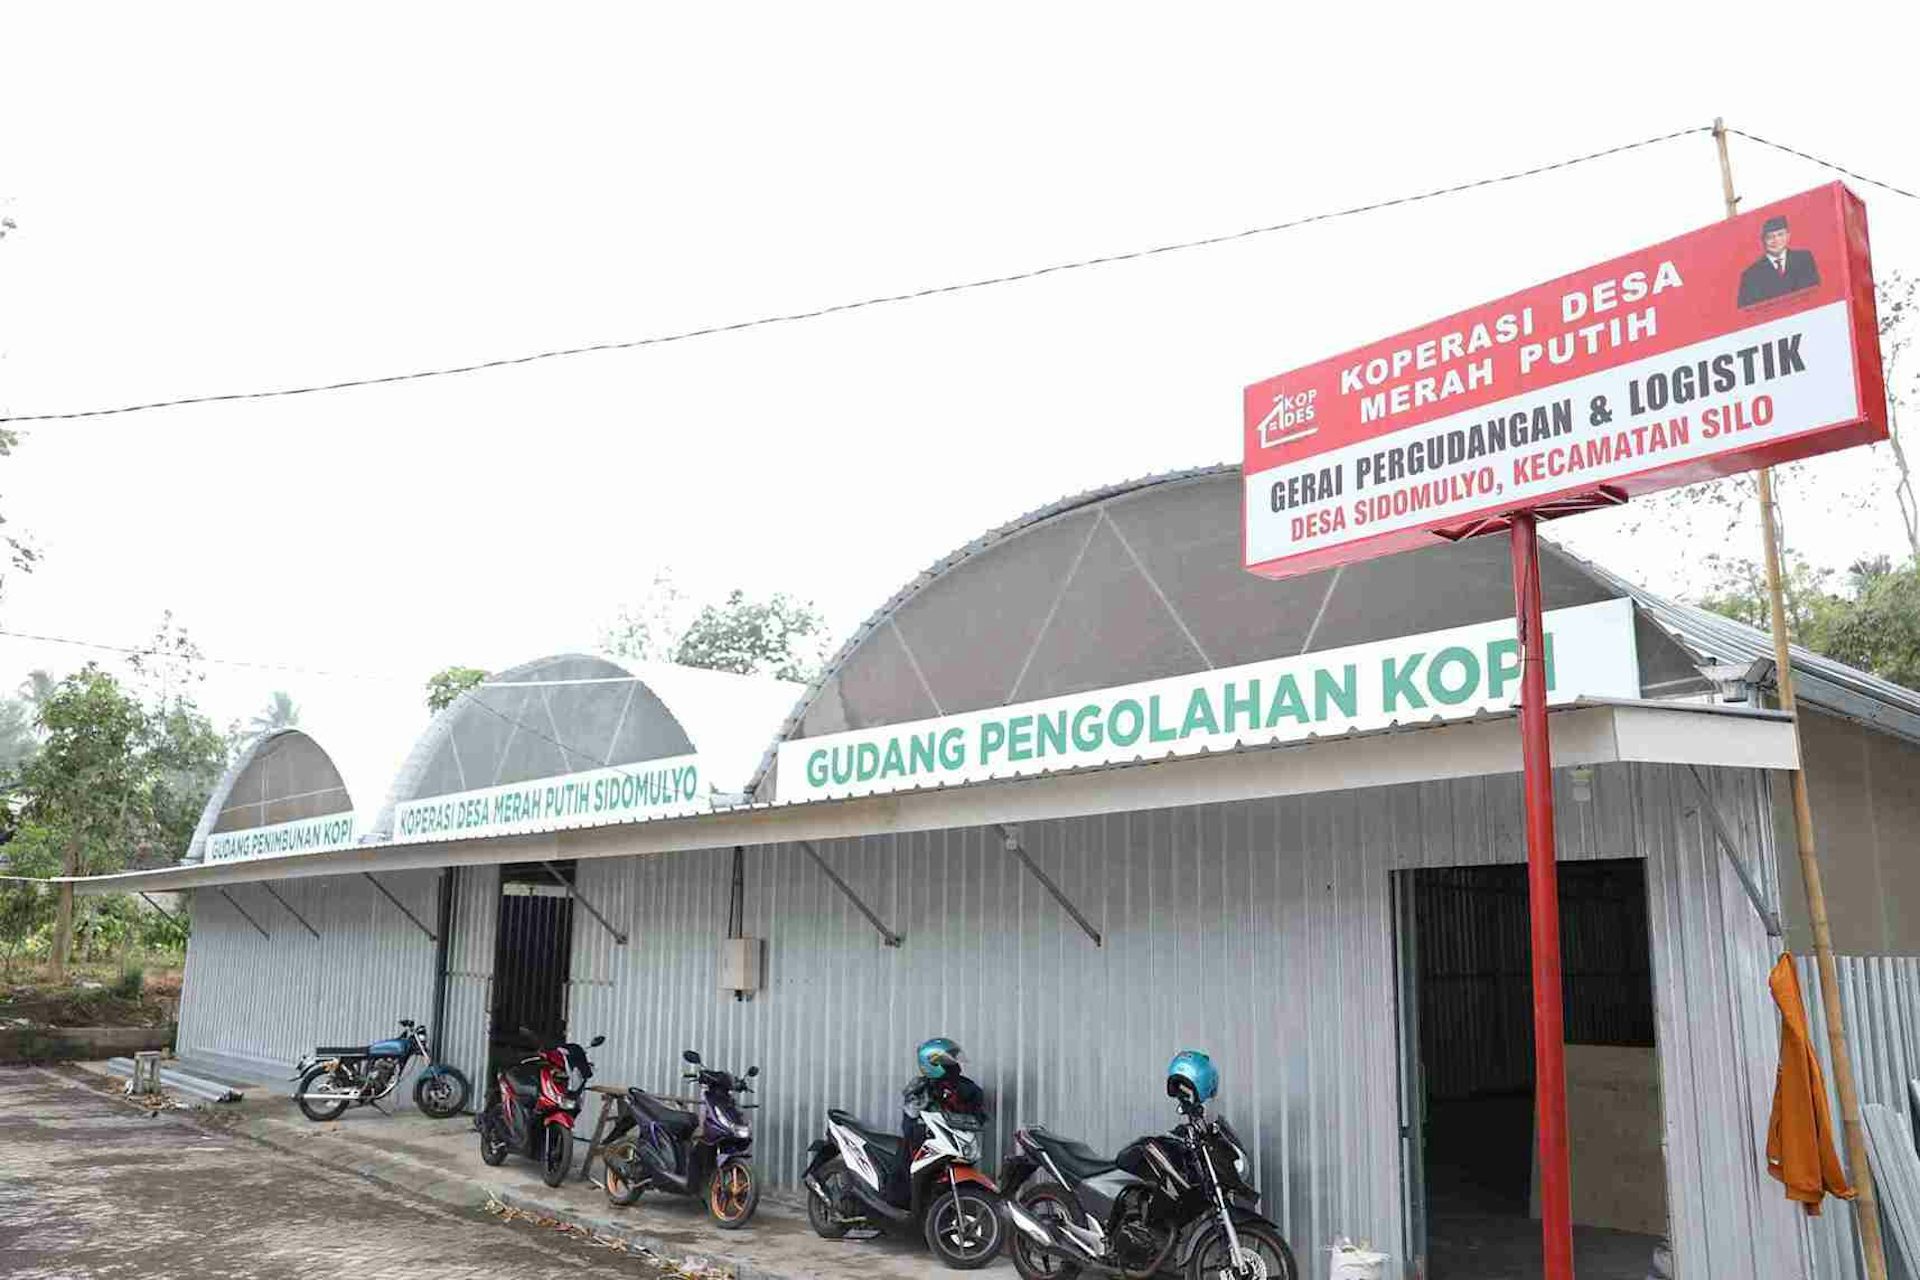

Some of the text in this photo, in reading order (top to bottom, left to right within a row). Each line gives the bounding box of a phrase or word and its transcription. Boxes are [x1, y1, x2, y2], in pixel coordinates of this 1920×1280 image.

[1340, 260, 1683, 395] KOPERASI DESA
[1360, 307, 1657, 423] MERAH PUTIH
[1271, 333, 1805, 513] GERAI PERGUDANGAN & LOGISTIK
[1284, 389, 1316, 408] KOP
[1284, 405, 1315, 424] DES
[1291, 394, 1774, 541] DESA SIDOMULYO, KECAMATAN SILO
[806, 632, 1556, 788] GUDANG PENGOLAHAN KOPI
[212, 818, 352, 859] GUDANG PENIMBUNAN KOPI
[400, 766, 697, 834] KOPERASI DESA MERAH PUTIH SIDOMULYO
